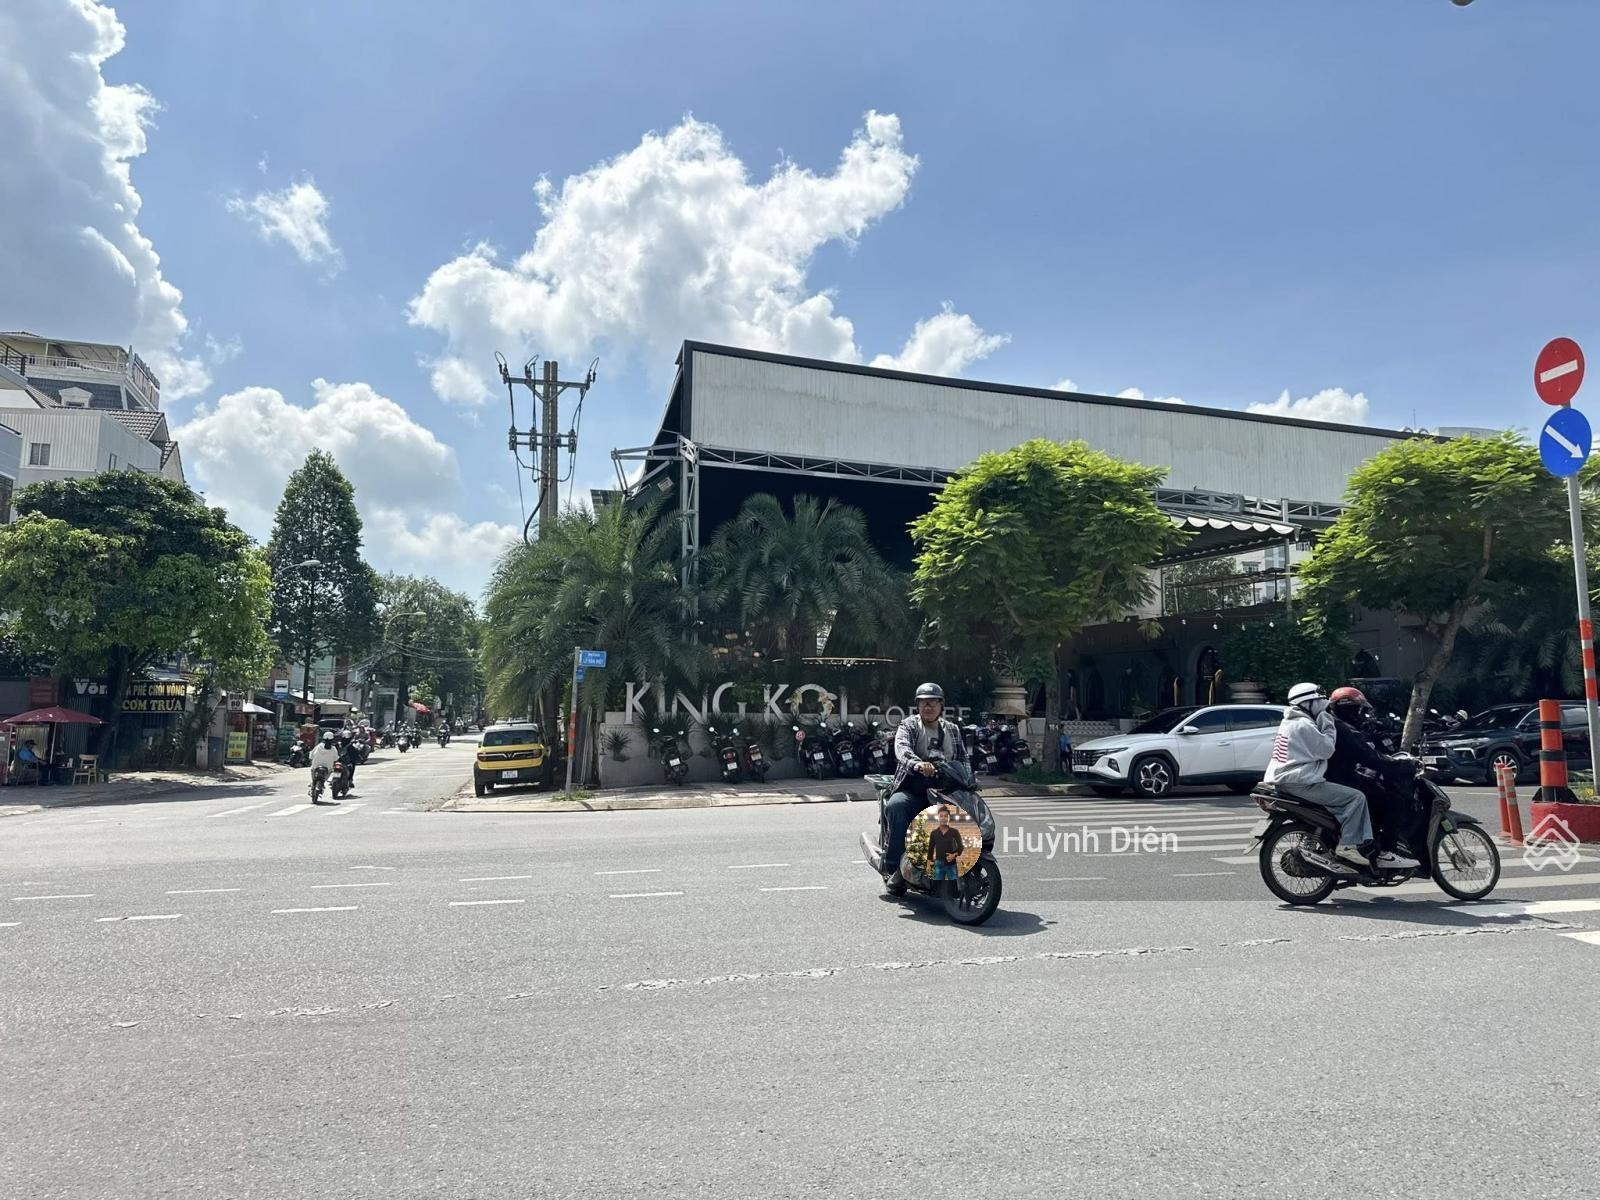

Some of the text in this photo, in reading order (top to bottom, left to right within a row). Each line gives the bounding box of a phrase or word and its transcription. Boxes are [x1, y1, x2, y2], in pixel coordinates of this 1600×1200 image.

[149, 698, 183, 711] TRƯA
[624, 682, 972, 727] KING KOI COFEE
